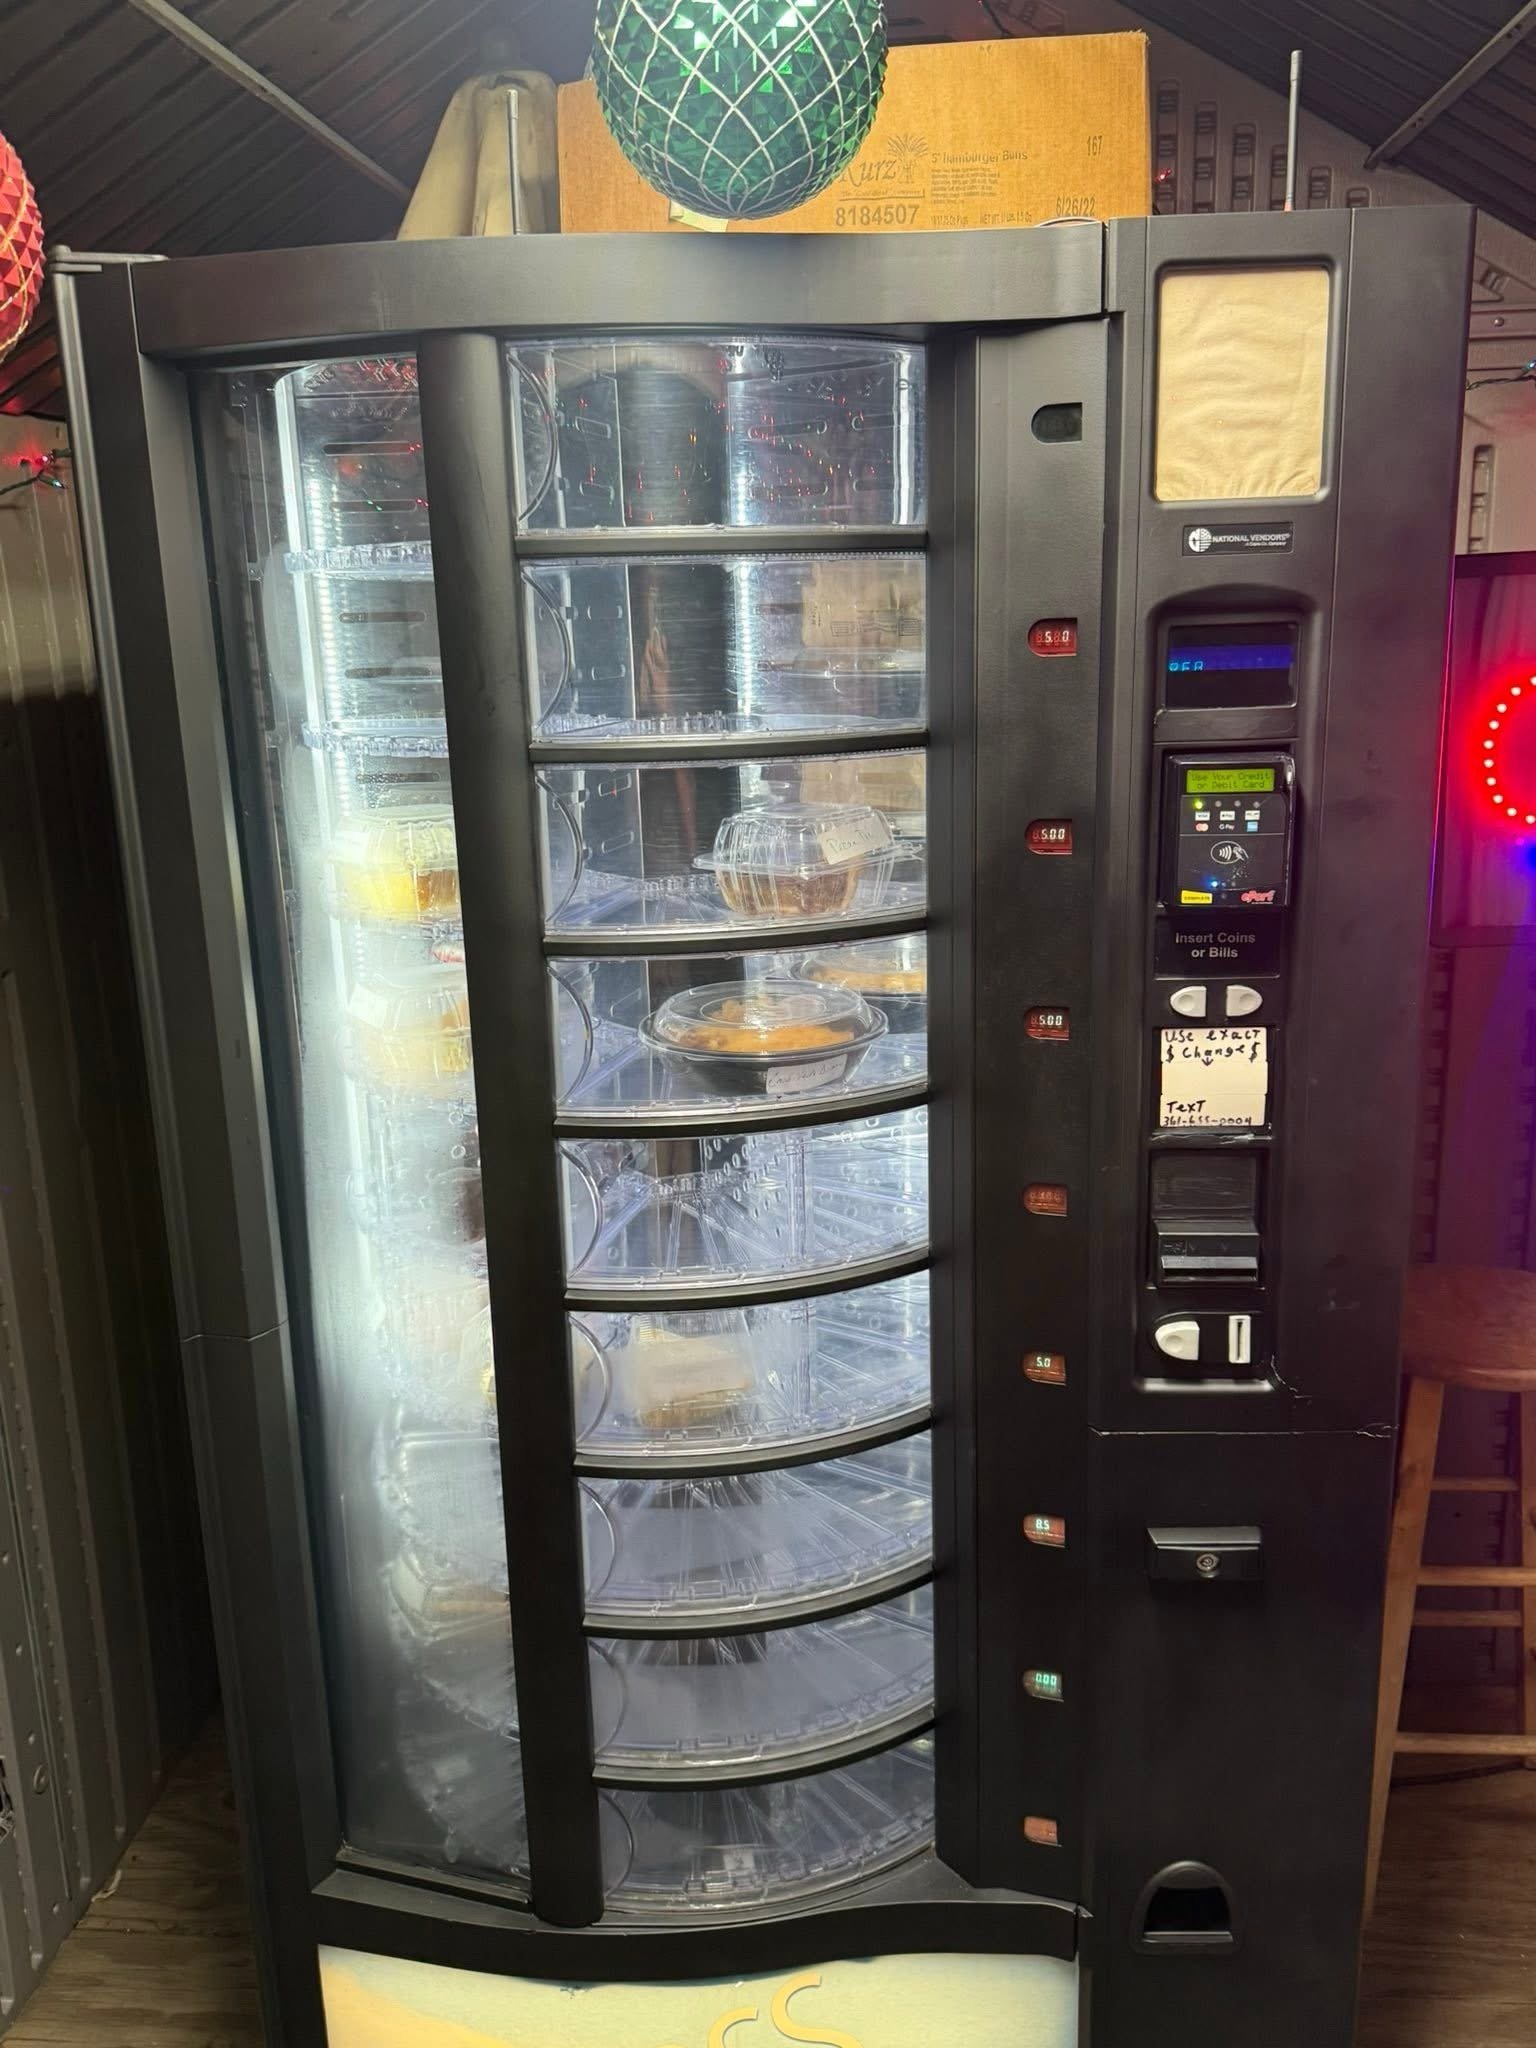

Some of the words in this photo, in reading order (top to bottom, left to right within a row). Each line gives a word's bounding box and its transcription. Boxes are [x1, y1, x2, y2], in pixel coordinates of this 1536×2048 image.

[1086, 136, 1102, 156] 167
[943, 152, 999, 164] Hamburger
[1003, 150, 1028, 161] Buns
[1056, 197, 1096, 216] 6/26/22
[836, 205, 920, 226] 8184507
[1212, 535, 1250, 543] NATIONAL
[1214, 771, 1236, 781] Your
[1238, 771, 1270, 781] Credit
[1212, 781, 1237, 789] Debit
[1243, 780, 1265, 788] Card
[1042, 828, 1065, 840] 5.00
[1175, 932, 1213, 944] Insert
[1217, 932, 1256, 944] Coins
[1191, 949, 1206, 958] or
[1209, 947, 1238, 958] Bills
[1040, 1015, 1062, 1026] 5.00
